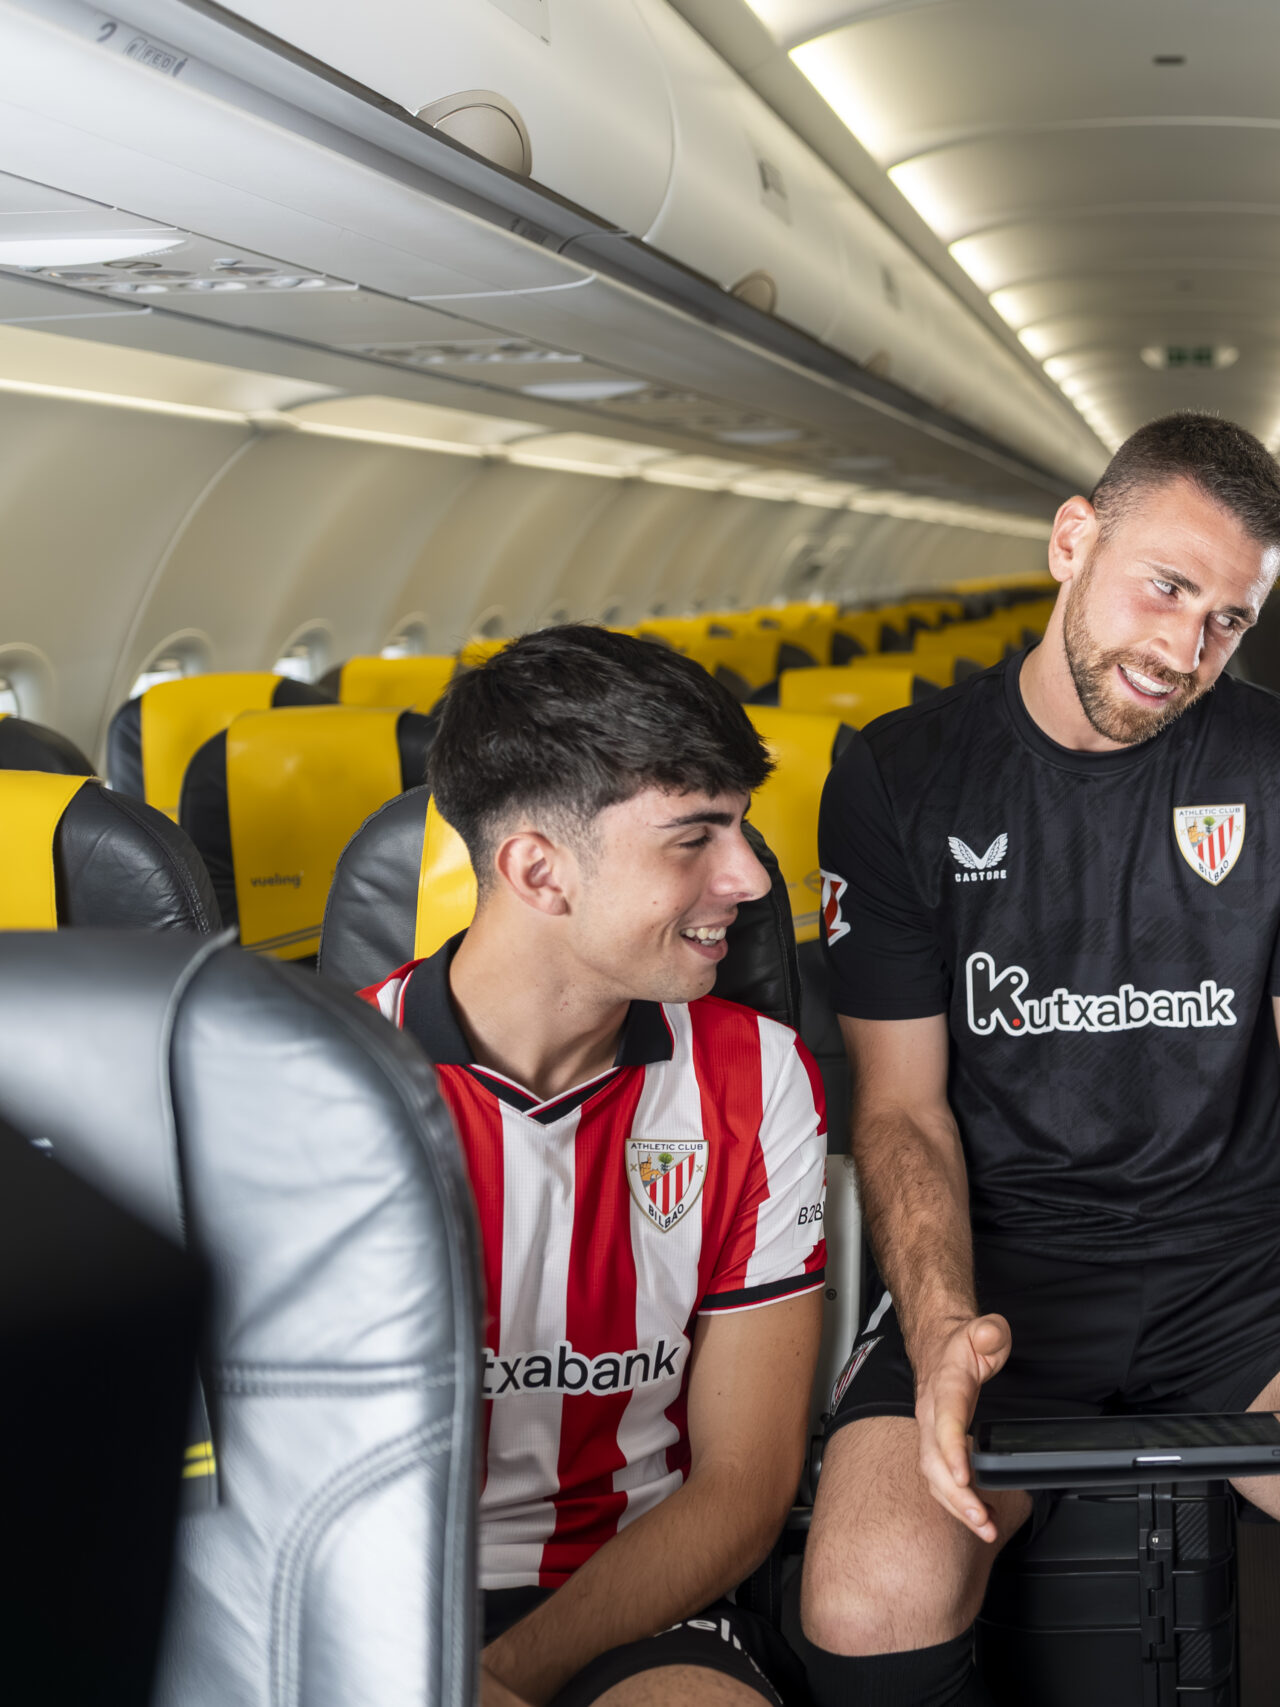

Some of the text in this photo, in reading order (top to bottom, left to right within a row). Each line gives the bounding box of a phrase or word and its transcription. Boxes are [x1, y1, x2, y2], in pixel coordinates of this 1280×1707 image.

[1179, 807, 1241, 817] ATHLETIC CLUB
[954, 869, 1007, 883] CASTORE
[1198, 859, 1230, 882] BILBAO
[969, 955, 1234, 1033] Kutxabank
[630, 1142, 704, 1152] ATHLETIC CLUB
[648, 1203, 685, 1229] BILBAO
[797, 1201, 826, 1226] B2B
